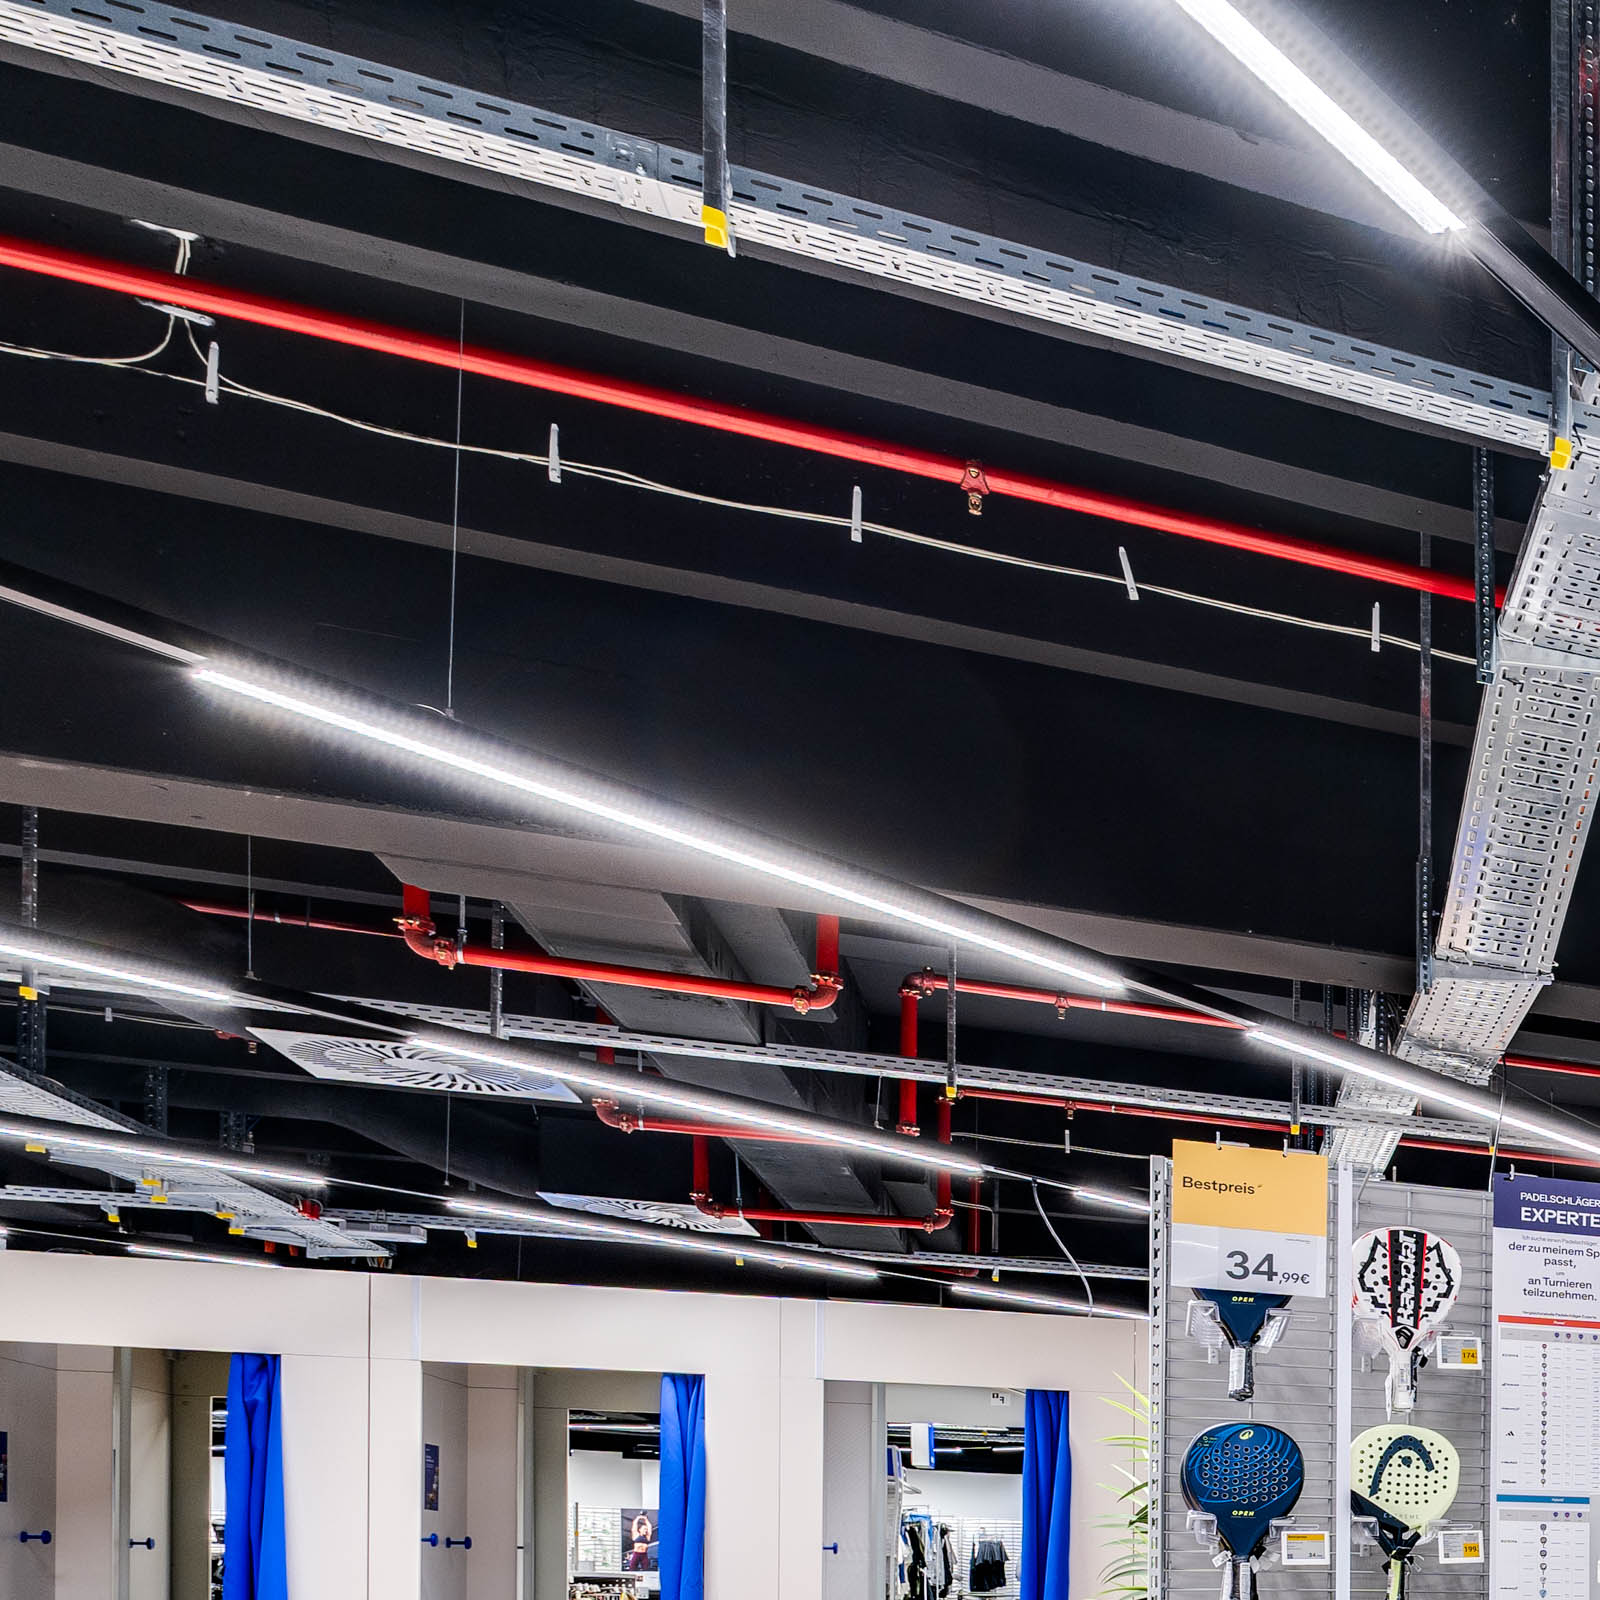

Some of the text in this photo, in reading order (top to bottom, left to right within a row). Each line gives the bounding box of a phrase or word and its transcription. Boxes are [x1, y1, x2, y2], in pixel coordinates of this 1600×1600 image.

[1182, 1176, 1255, 1194] Bestpreis
[1520, 1206, 1600, 1228] EXPERTE
[1508, 1242, 1526, 1251] der
[1528, 1244, 1541, 1253] zu
[1542, 1245, 1584, 1257] meinem
[1225, 1250, 1310, 1284] 34,99€
[1544, 1257, 1577, 1269] passt,
[1528, 1277, 1592, 1289] an Turnieren
[1523, 1288, 1597, 1301] teilzunehmen.
